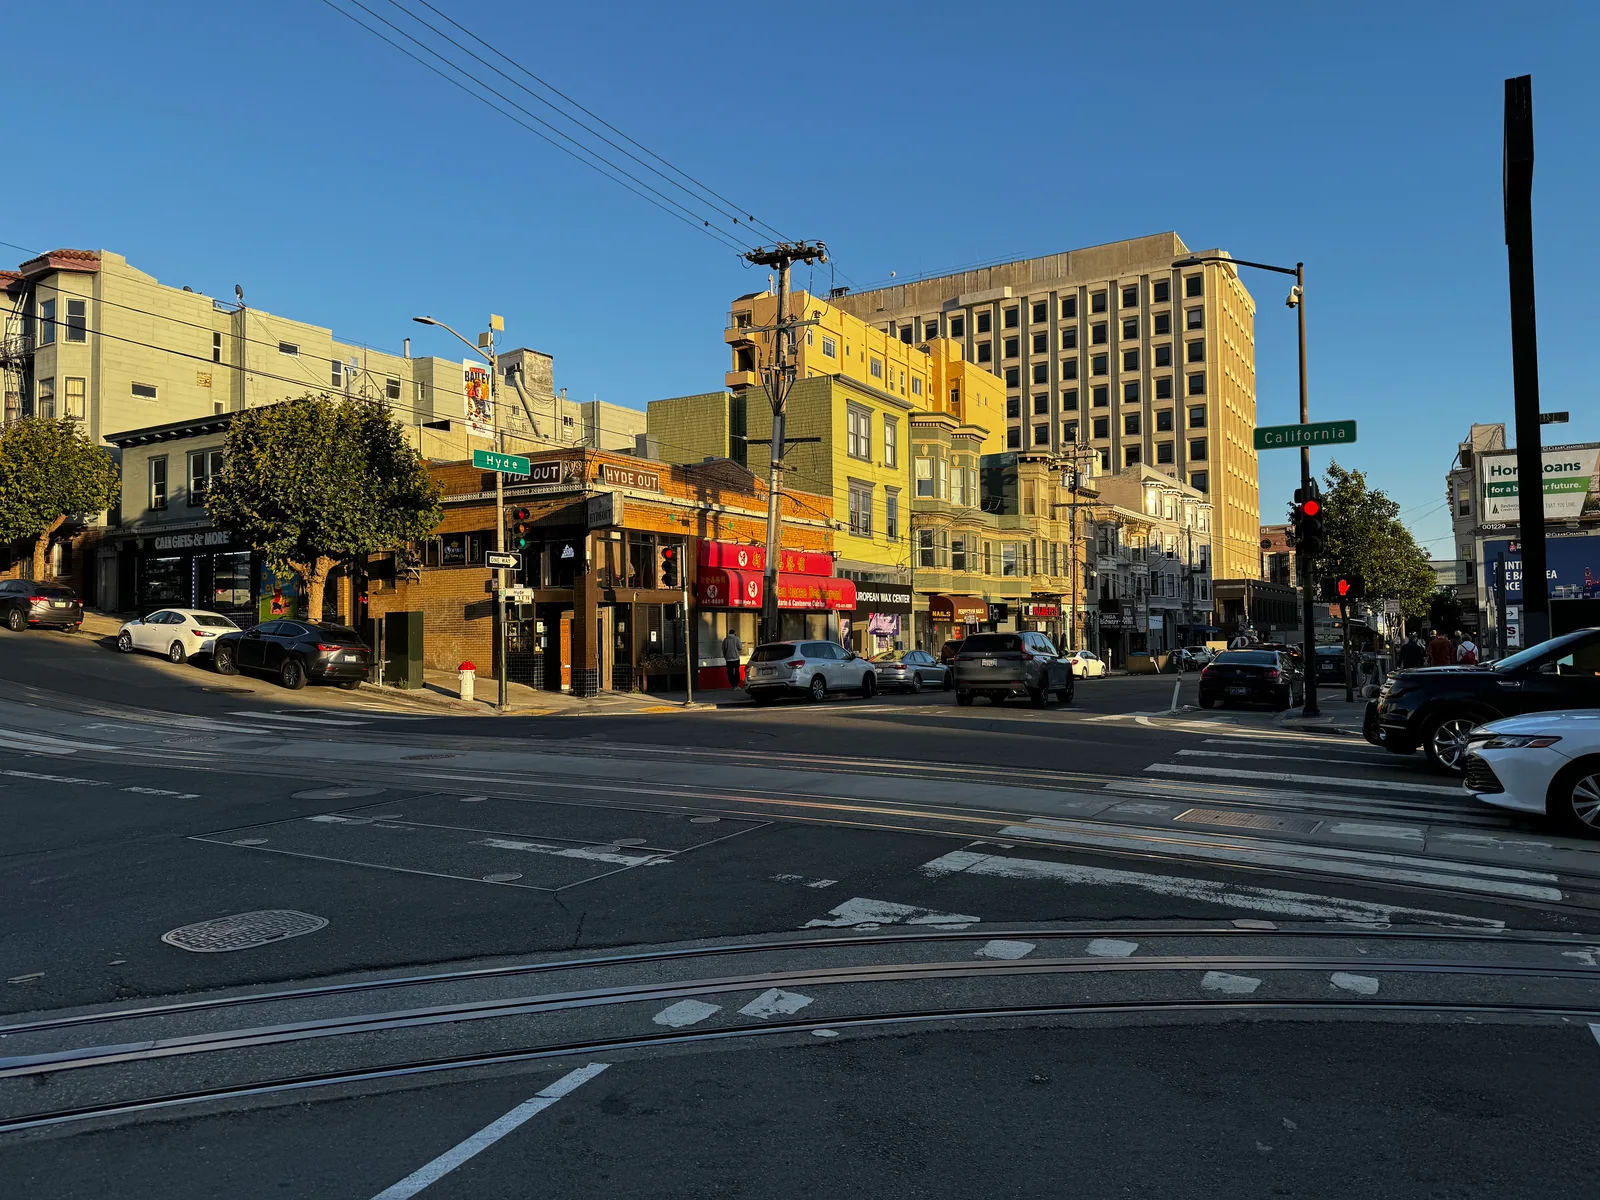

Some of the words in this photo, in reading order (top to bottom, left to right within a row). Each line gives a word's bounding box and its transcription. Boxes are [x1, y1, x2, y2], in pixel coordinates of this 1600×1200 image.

[464, 370, 490, 384] BAILEY
[1264, 428, 1345, 444] California
[486, 455, 518, 468] Hyde
[533, 466, 558, 480] OUT
[1490, 465, 1518, 476] Ho
[1542, 462, 1581, 473] oans
[606, 468, 634, 484] HYDE
[638, 474, 657, 488] OUT
[1491, 486, 1504, 494] for
[1550, 482, 1582, 490] future.
[194, 534, 204, 546] &
[204, 530, 230, 546] MORE
[490, 556, 500, 564] ONE
[501, 558, 511, 566] WAY
[808, 586, 842, 600] Restaurant
[856, 591, 880, 602] UROPEAN
[880, 592, 892, 602] WAX
[892, 594, 910, 604] CENTER
